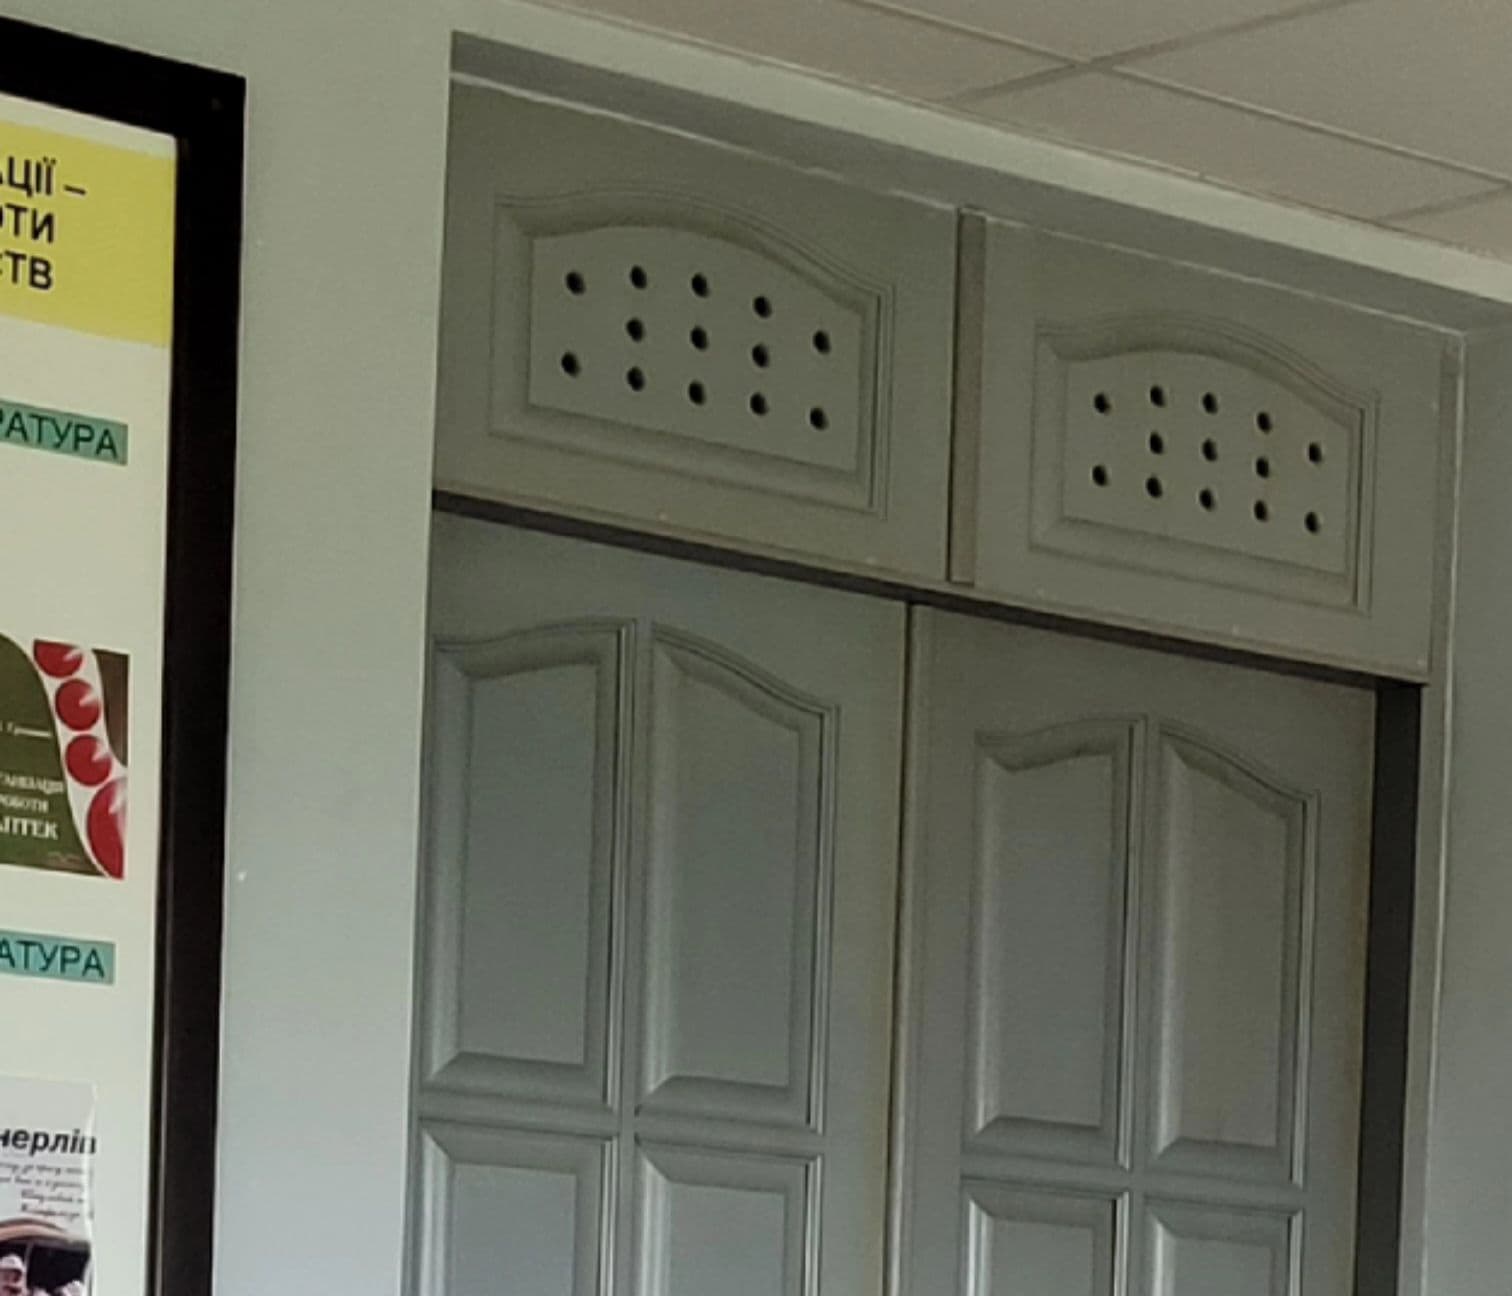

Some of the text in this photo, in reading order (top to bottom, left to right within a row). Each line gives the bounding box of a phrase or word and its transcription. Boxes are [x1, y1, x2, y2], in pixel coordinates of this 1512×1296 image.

[0, 155, 57, 198] ЦІЇ
[0, 202, 55, 244] ТИ
[0, 250, 53, 290] ТВ
[0, 407, 118, 460] АТУРА
